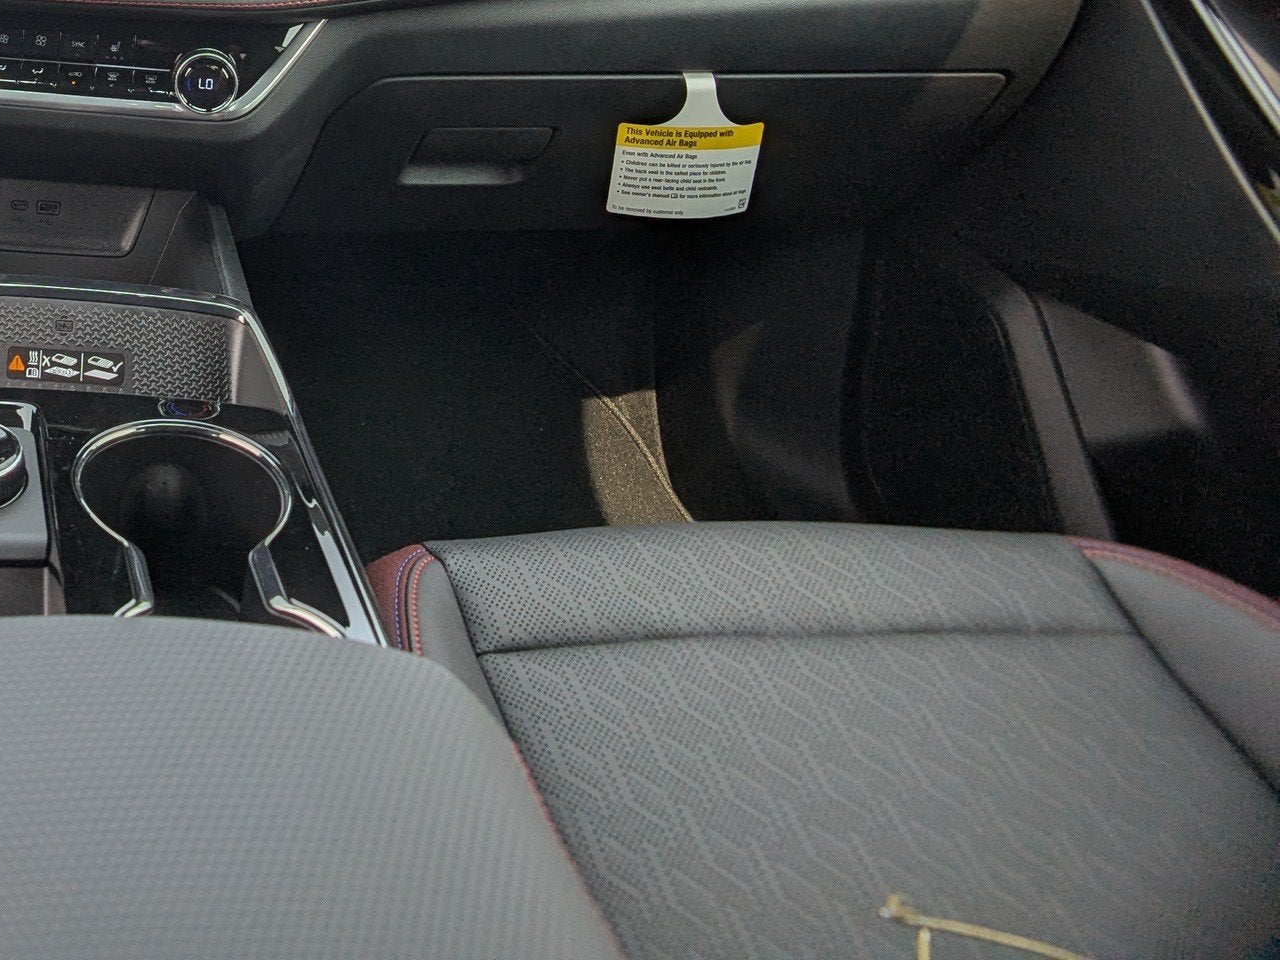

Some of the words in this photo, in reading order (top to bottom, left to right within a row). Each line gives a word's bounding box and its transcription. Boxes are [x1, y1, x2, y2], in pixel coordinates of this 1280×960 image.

[71, 40, 86, 48] SYNC
[626, 127, 643, 136] This
[645, 129, 674, 137] Vehicle
[684, 130, 718, 139] Equipped
[624, 136, 664, 146] Advanced
[679, 139, 698, 148] Bags
